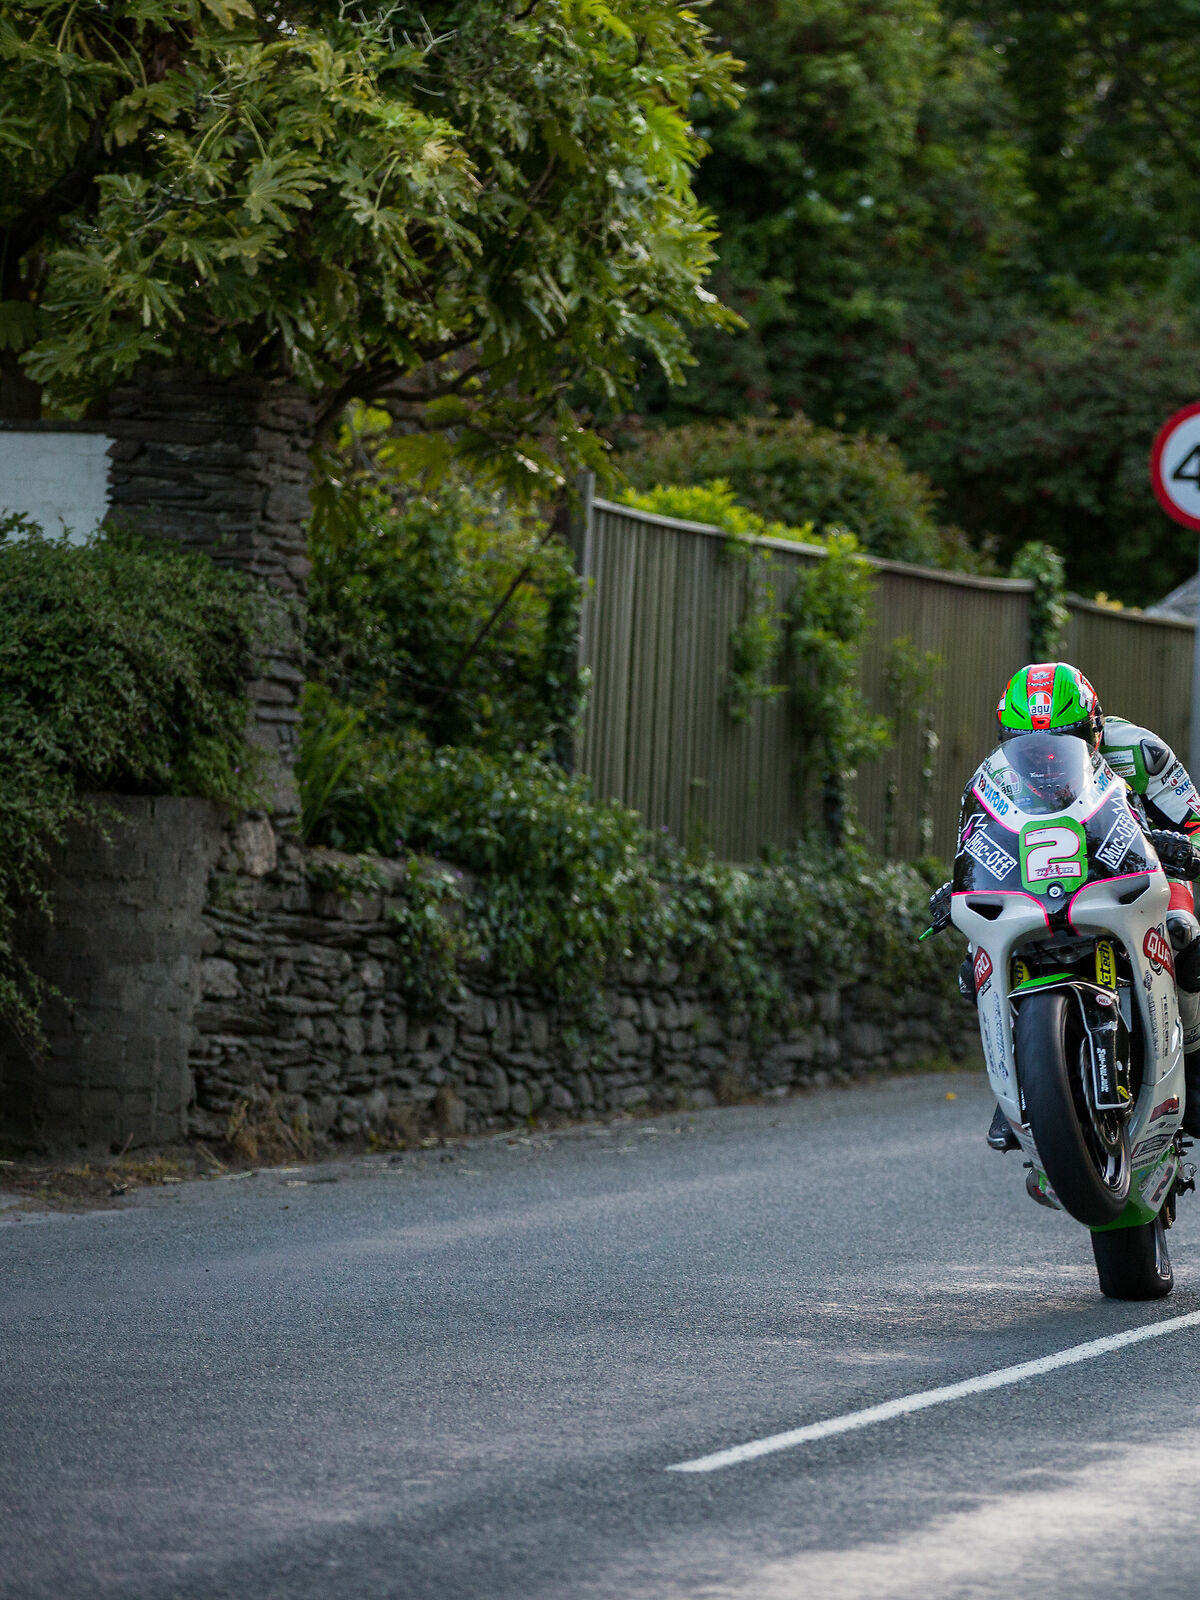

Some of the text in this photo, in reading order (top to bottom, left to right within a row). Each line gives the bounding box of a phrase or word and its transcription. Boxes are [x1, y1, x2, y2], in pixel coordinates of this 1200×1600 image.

[1031, 705, 1050, 715] agv
[984, 783, 1009, 816] OXFORD
[1025, 826, 1082, 883] 2
